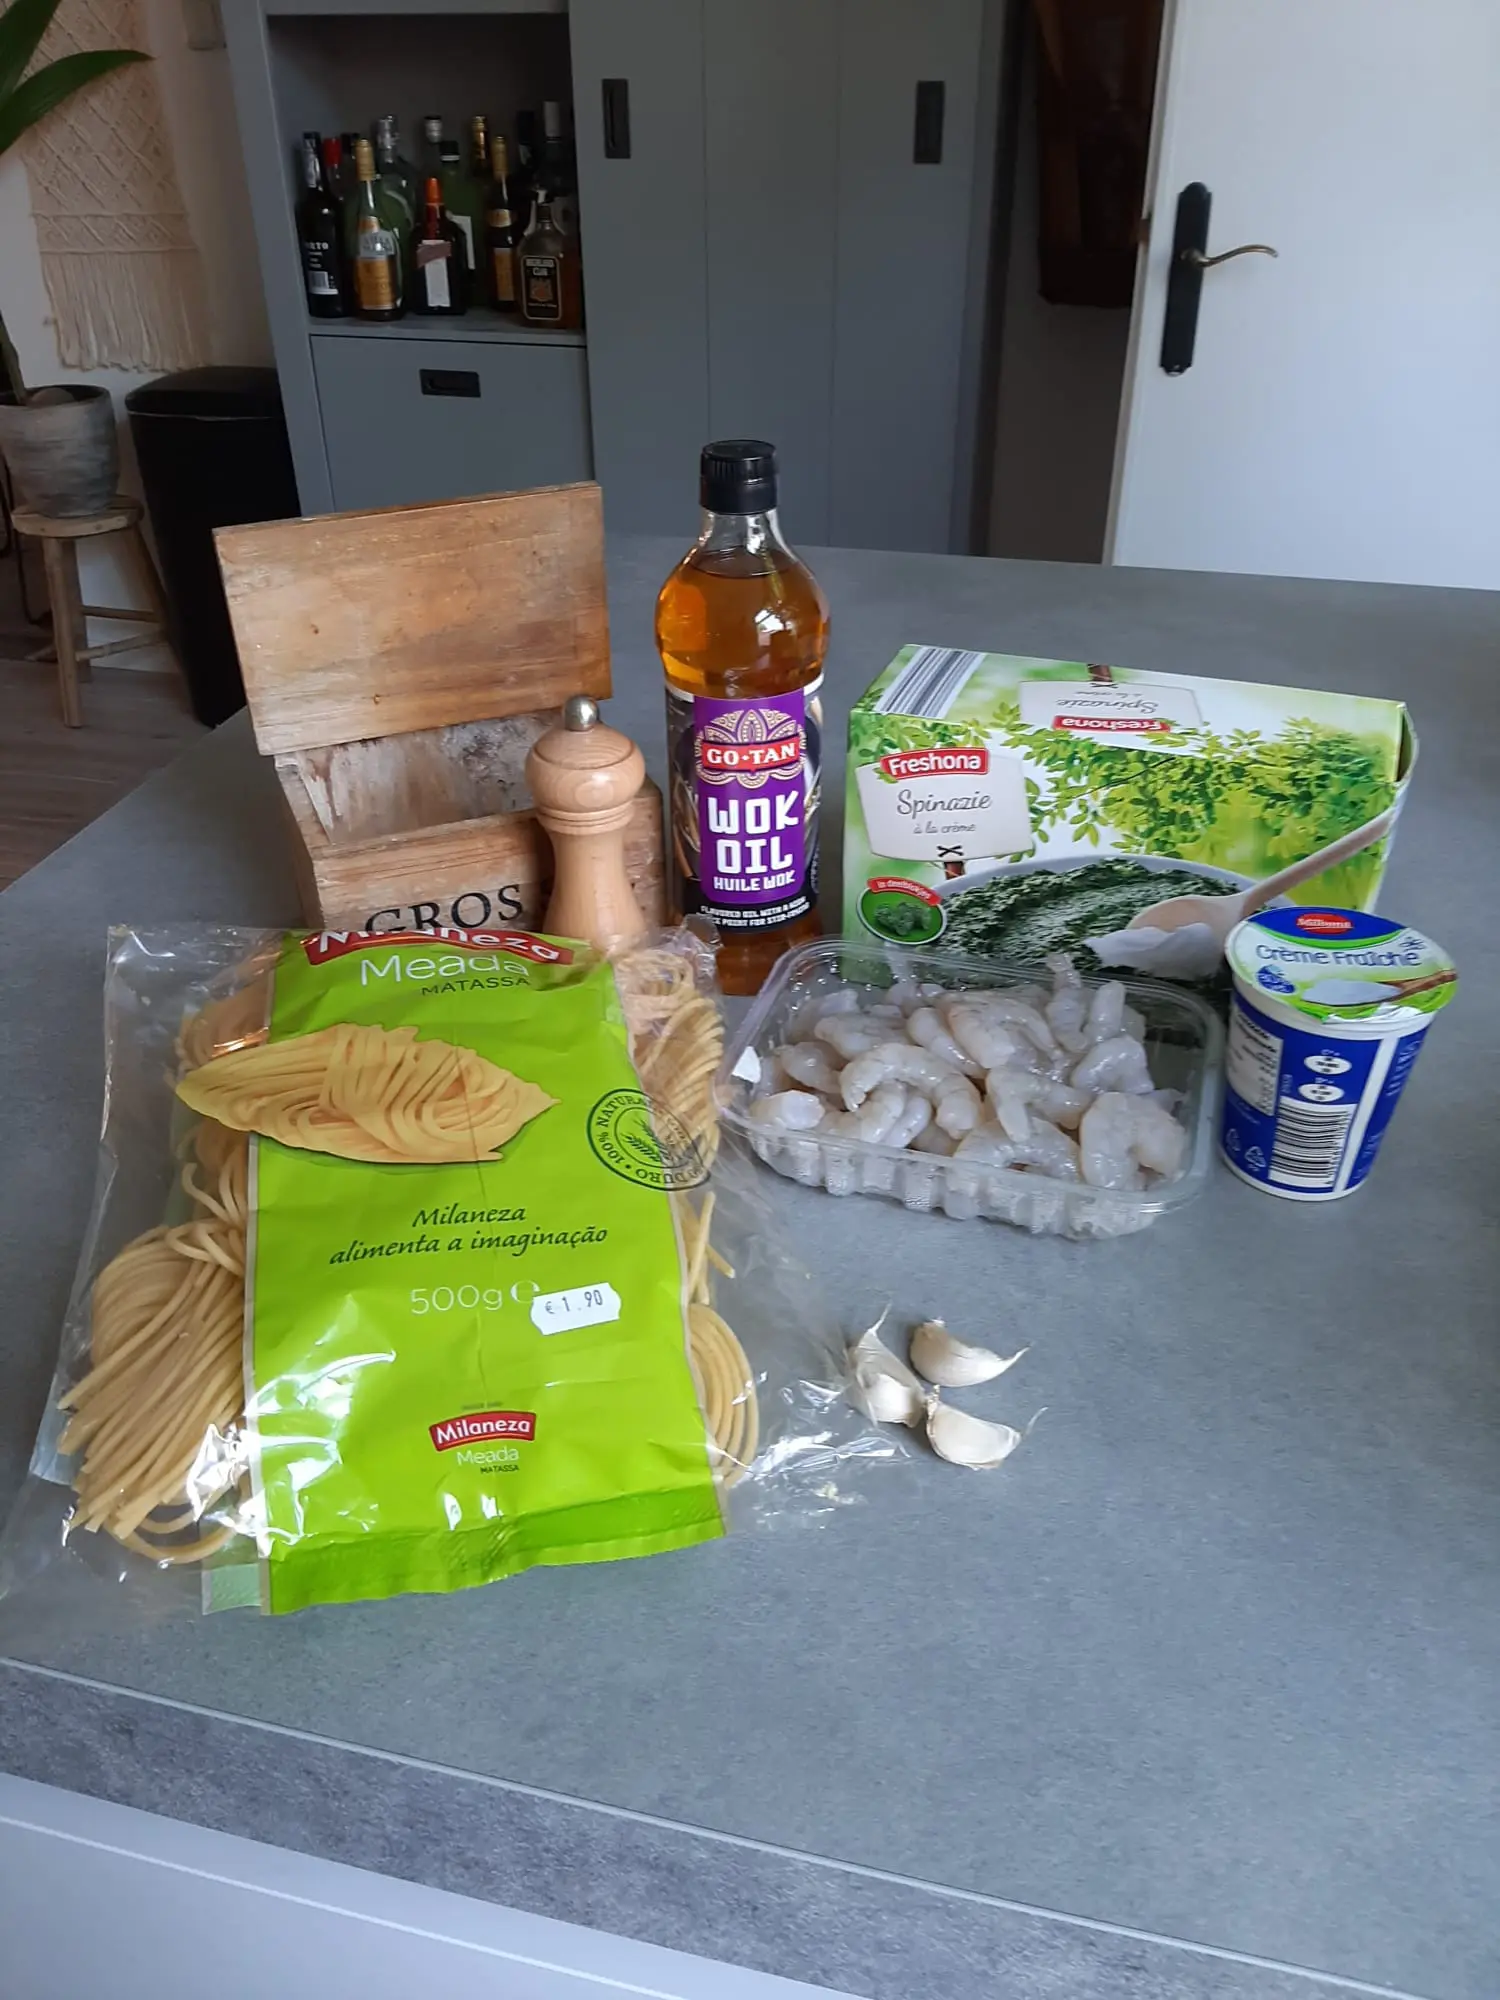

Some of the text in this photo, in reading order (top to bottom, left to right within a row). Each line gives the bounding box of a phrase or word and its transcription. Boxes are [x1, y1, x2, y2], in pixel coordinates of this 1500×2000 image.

[1062, 717, 1162, 731] Freshona
[888, 753, 982, 776] Freshona
[707, 790, 799, 835] WOK
[896, 789, 992, 820] Spinazie
[716, 835, 793, 875] OIL
[713, 869, 796, 892] HUILE WOK
[364, 883, 524, 932] GROS
[318, 926, 561, 962] Mneza
[1256, 943, 1329, 965] Crème
[359, 953, 530, 986] Meada
[421, 976, 531, 997] MATASSA
[411, 1202, 527, 1228] Milaneza
[328, 1226, 608, 1265] alimenta a imaginação
[410, 1284, 504, 1315] 500g
[436, 1419, 531, 1444] Milaneza
[456, 1446, 519, 1466] Meada
[480, 1464, 520, 1474] MATASSA
